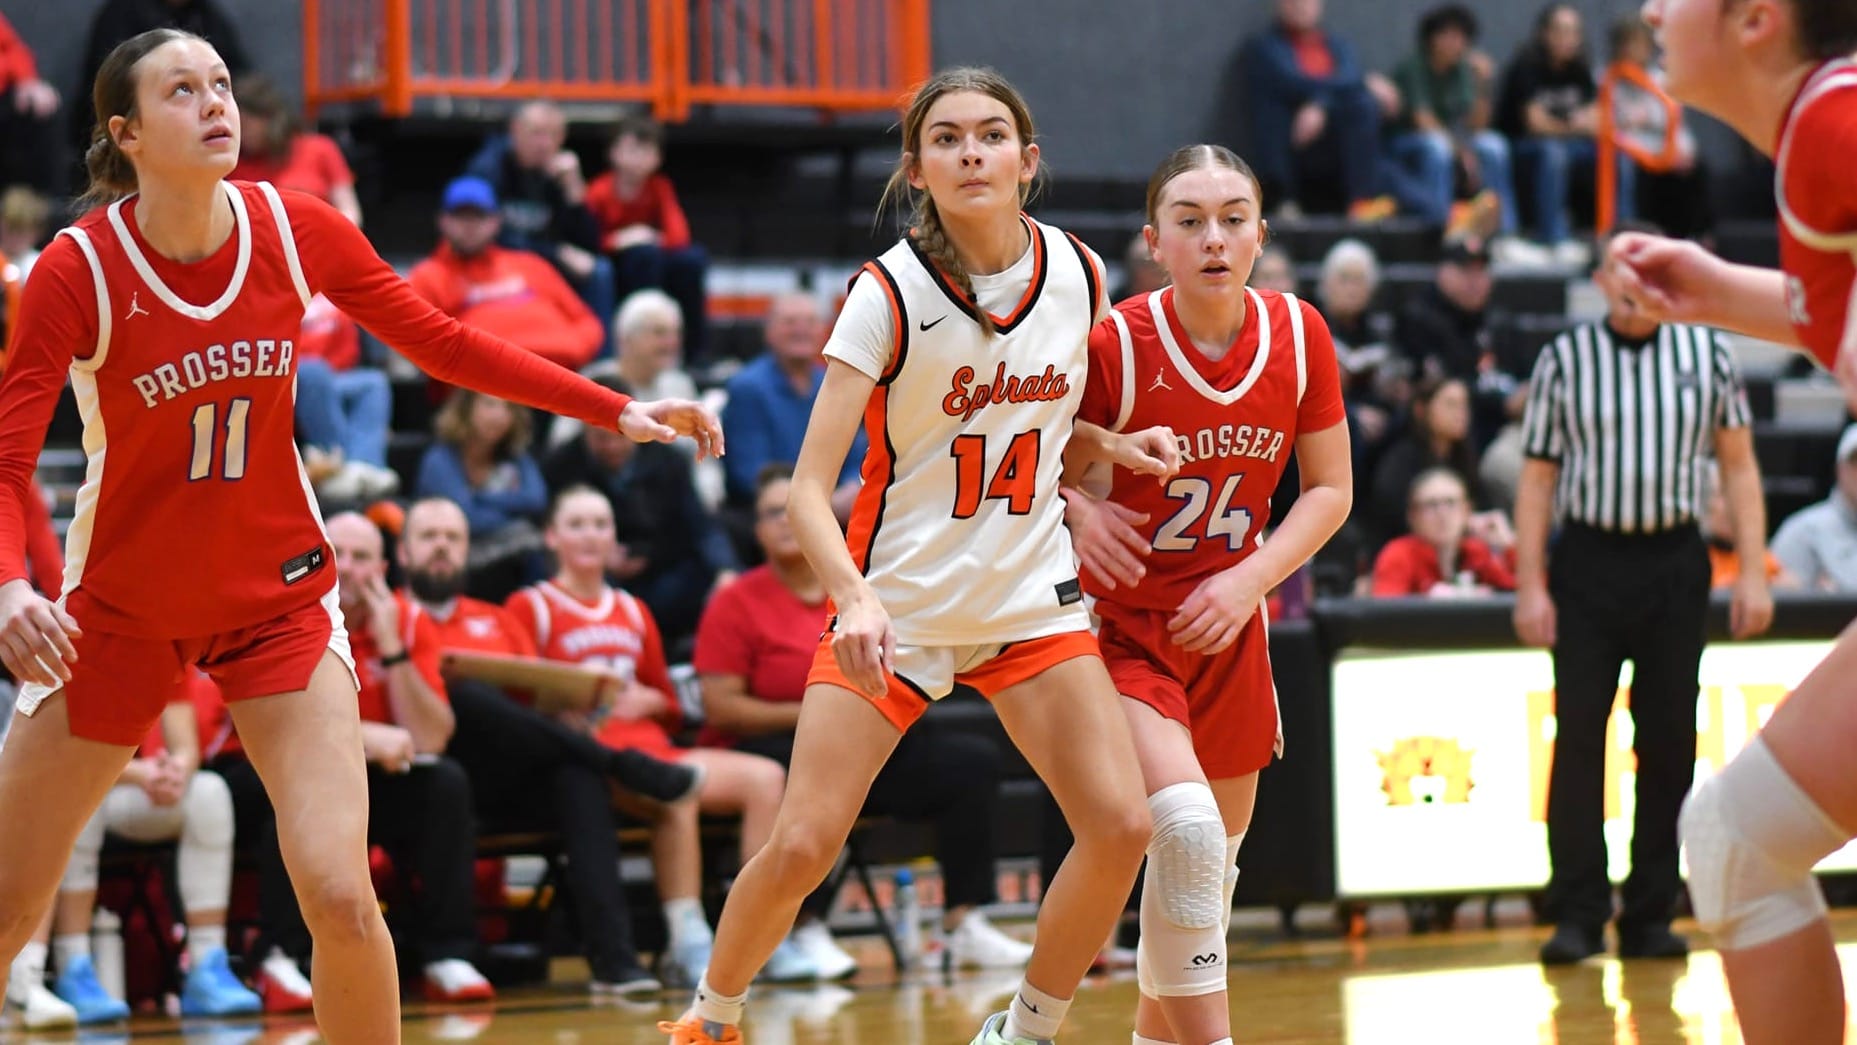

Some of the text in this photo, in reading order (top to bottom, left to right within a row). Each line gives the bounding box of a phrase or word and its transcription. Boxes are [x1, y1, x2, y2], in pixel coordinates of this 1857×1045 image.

[132, 338, 294, 409] PROSSER
[942, 360, 1070, 422] Ephrata
[187, 396, 252, 481] 11
[950, 428, 1042, 519] 14
[1175, 424, 1285, 466] ROSSER
[1151, 472, 1253, 552] 24
